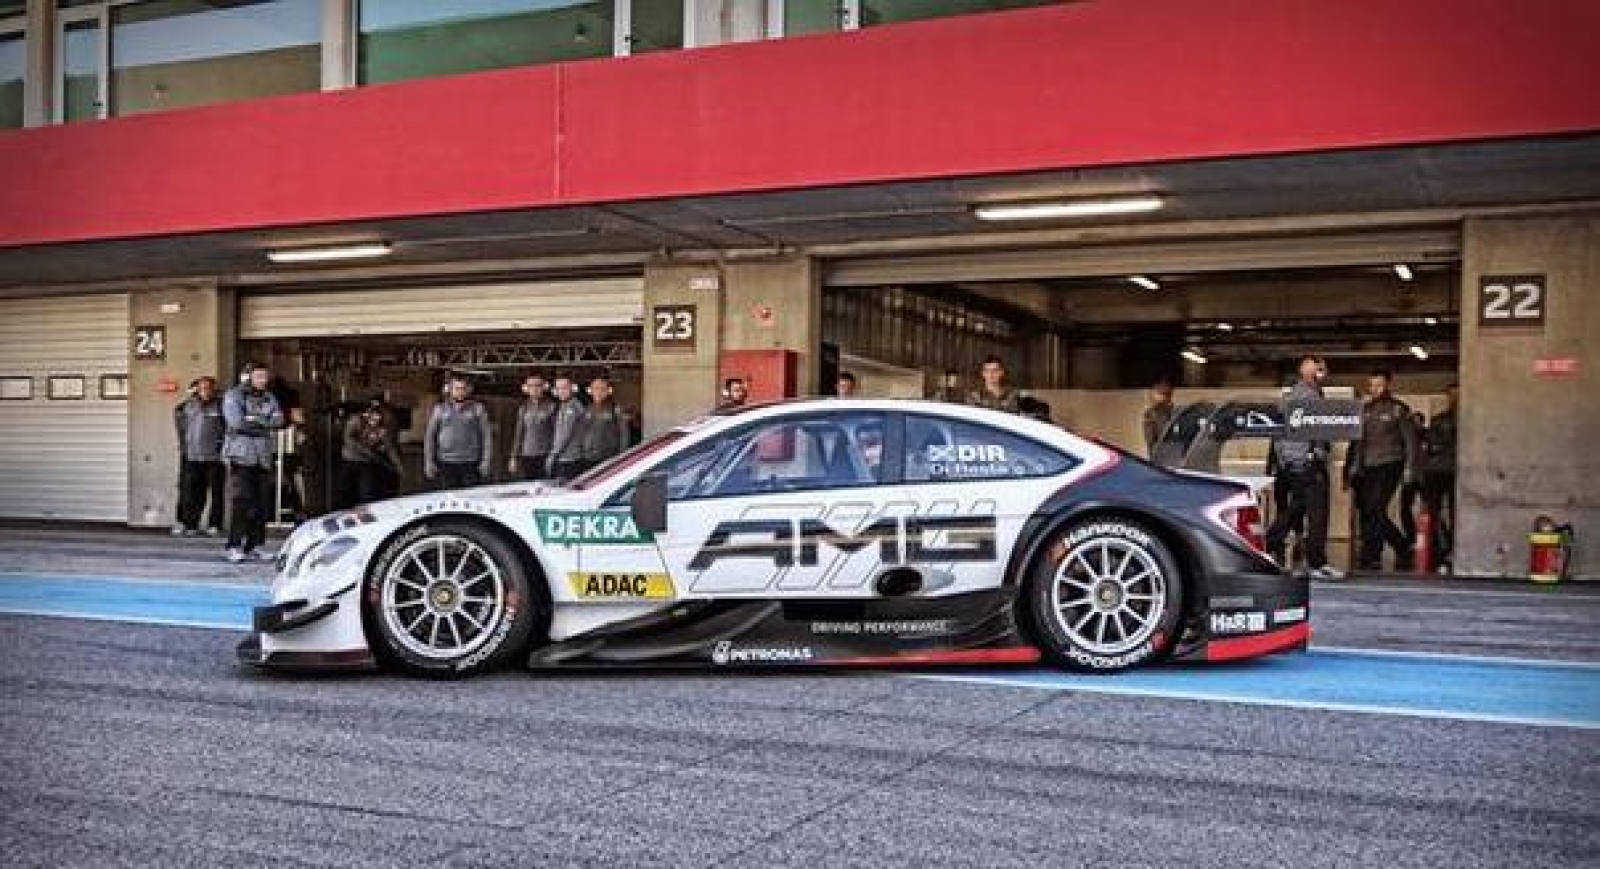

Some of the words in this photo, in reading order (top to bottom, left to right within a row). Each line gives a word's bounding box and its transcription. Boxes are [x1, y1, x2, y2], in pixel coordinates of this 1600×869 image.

[1483, 284, 1541, 319] 22
[655, 310, 693, 340] 23
[137, 329, 164, 354] 24
[958, 445, 1005, 462] DIR
[547, 514, 640, 540] DEKRA
[687, 516, 997, 570] AMG
[584, 574, 649, 596] ADAC
[731, 646, 812, 661] PETRONAS
